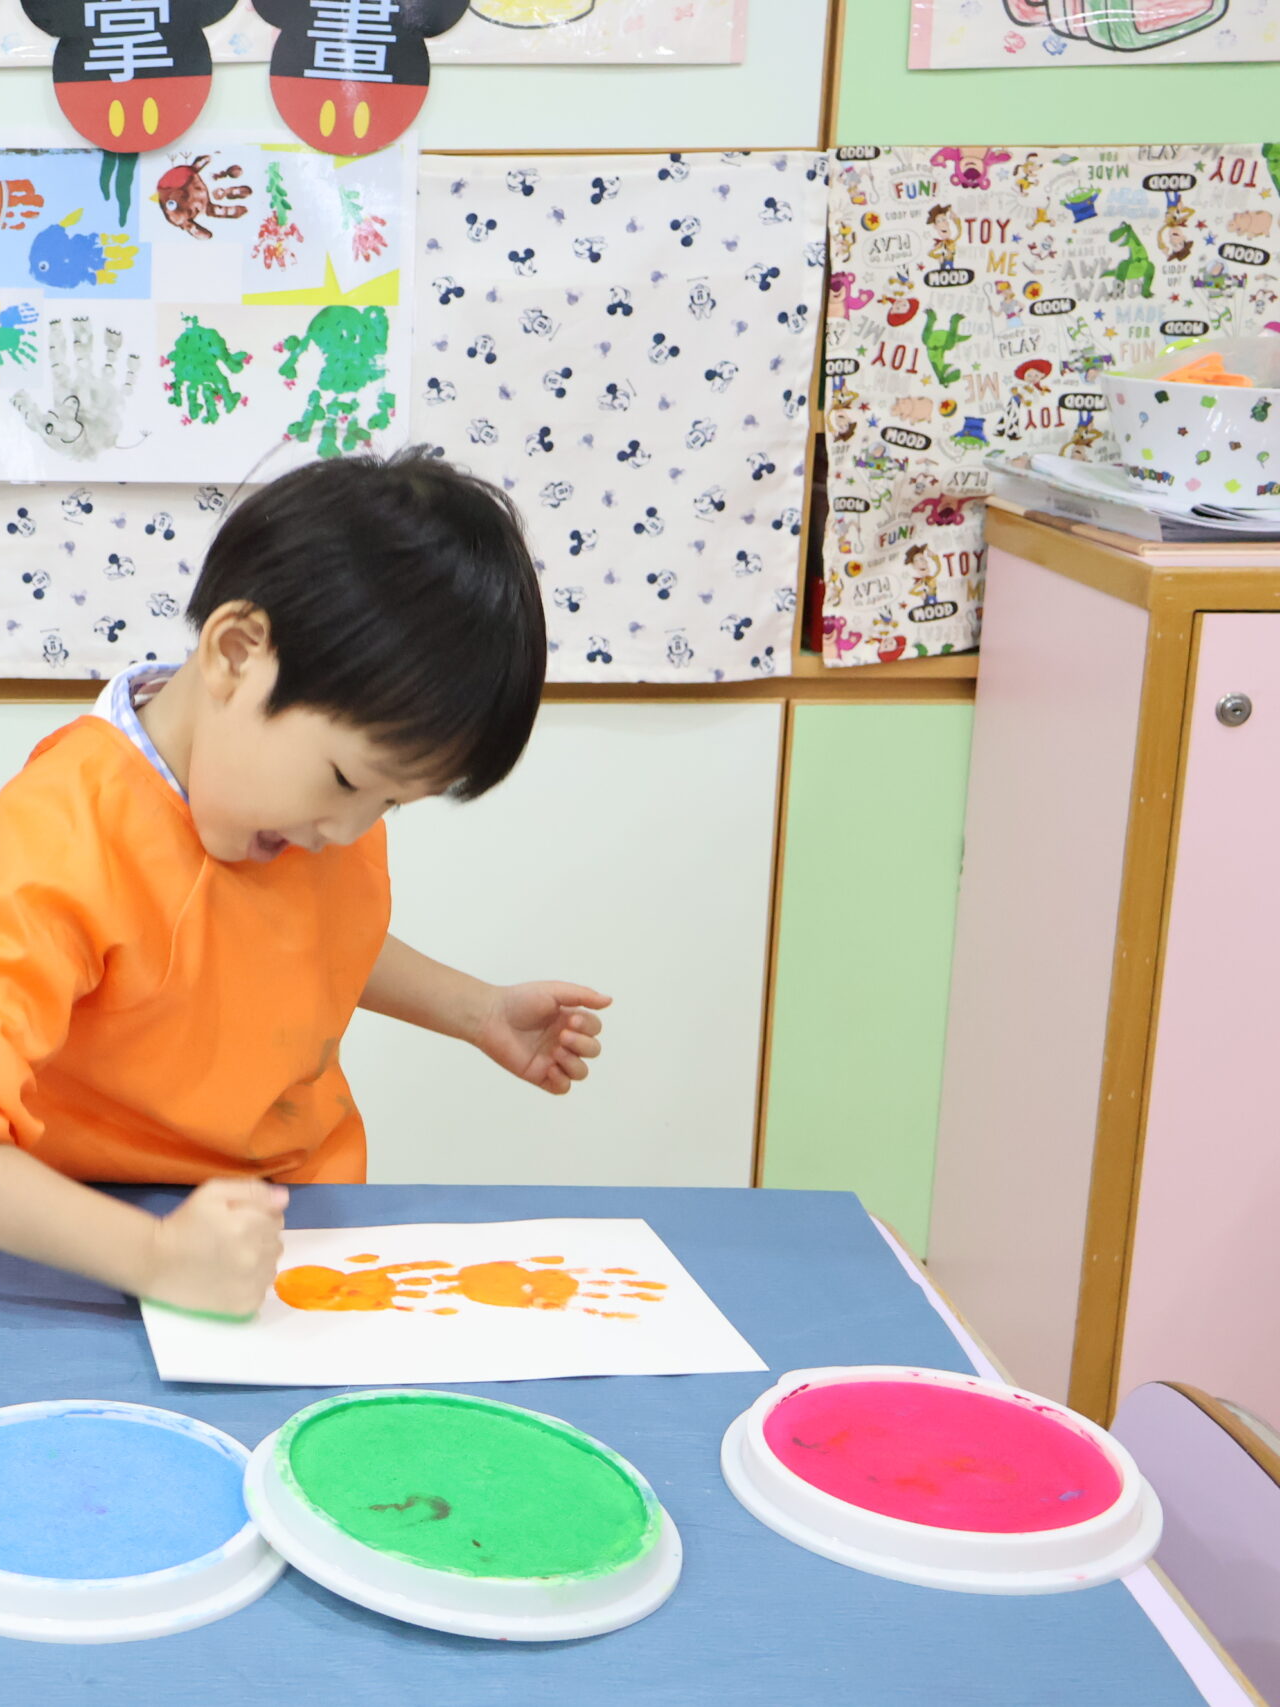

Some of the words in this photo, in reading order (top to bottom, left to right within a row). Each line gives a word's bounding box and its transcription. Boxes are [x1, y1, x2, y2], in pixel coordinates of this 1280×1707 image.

[84, 0, 174, 83] 掌
[303, 0, 400, 83] 畫
[1088, 164, 1130, 181] MADE
[1148, 174, 1193, 191] MOOD
[1209, 155, 1259, 189] TOY
[894, 179, 938, 200] FUN!
[964, 218, 1011, 244] TOY
[985, 249, 1020, 277] ME
[1222, 244, 1266, 265] MOOD
[928, 270, 970, 286] MOOD
[1033, 301, 1072, 315] MOOD
[1128, 326, 1151, 339] FOR
[1164, 322, 1205, 336] MOOD
[870, 341, 920, 374] TOY
[1121, 341, 1157, 365] FUN
[826, 358, 856, 376] MOO
[963, 371, 1001, 404] ME
[1064, 394, 1106, 411] MOOD
[1024, 406, 1066, 431] TOY
[885, 428, 927, 450] MOOD
[879, 525, 915, 548] FUN!
[943, 551, 986, 578] TOY
[913, 605, 954, 621] MOOD
